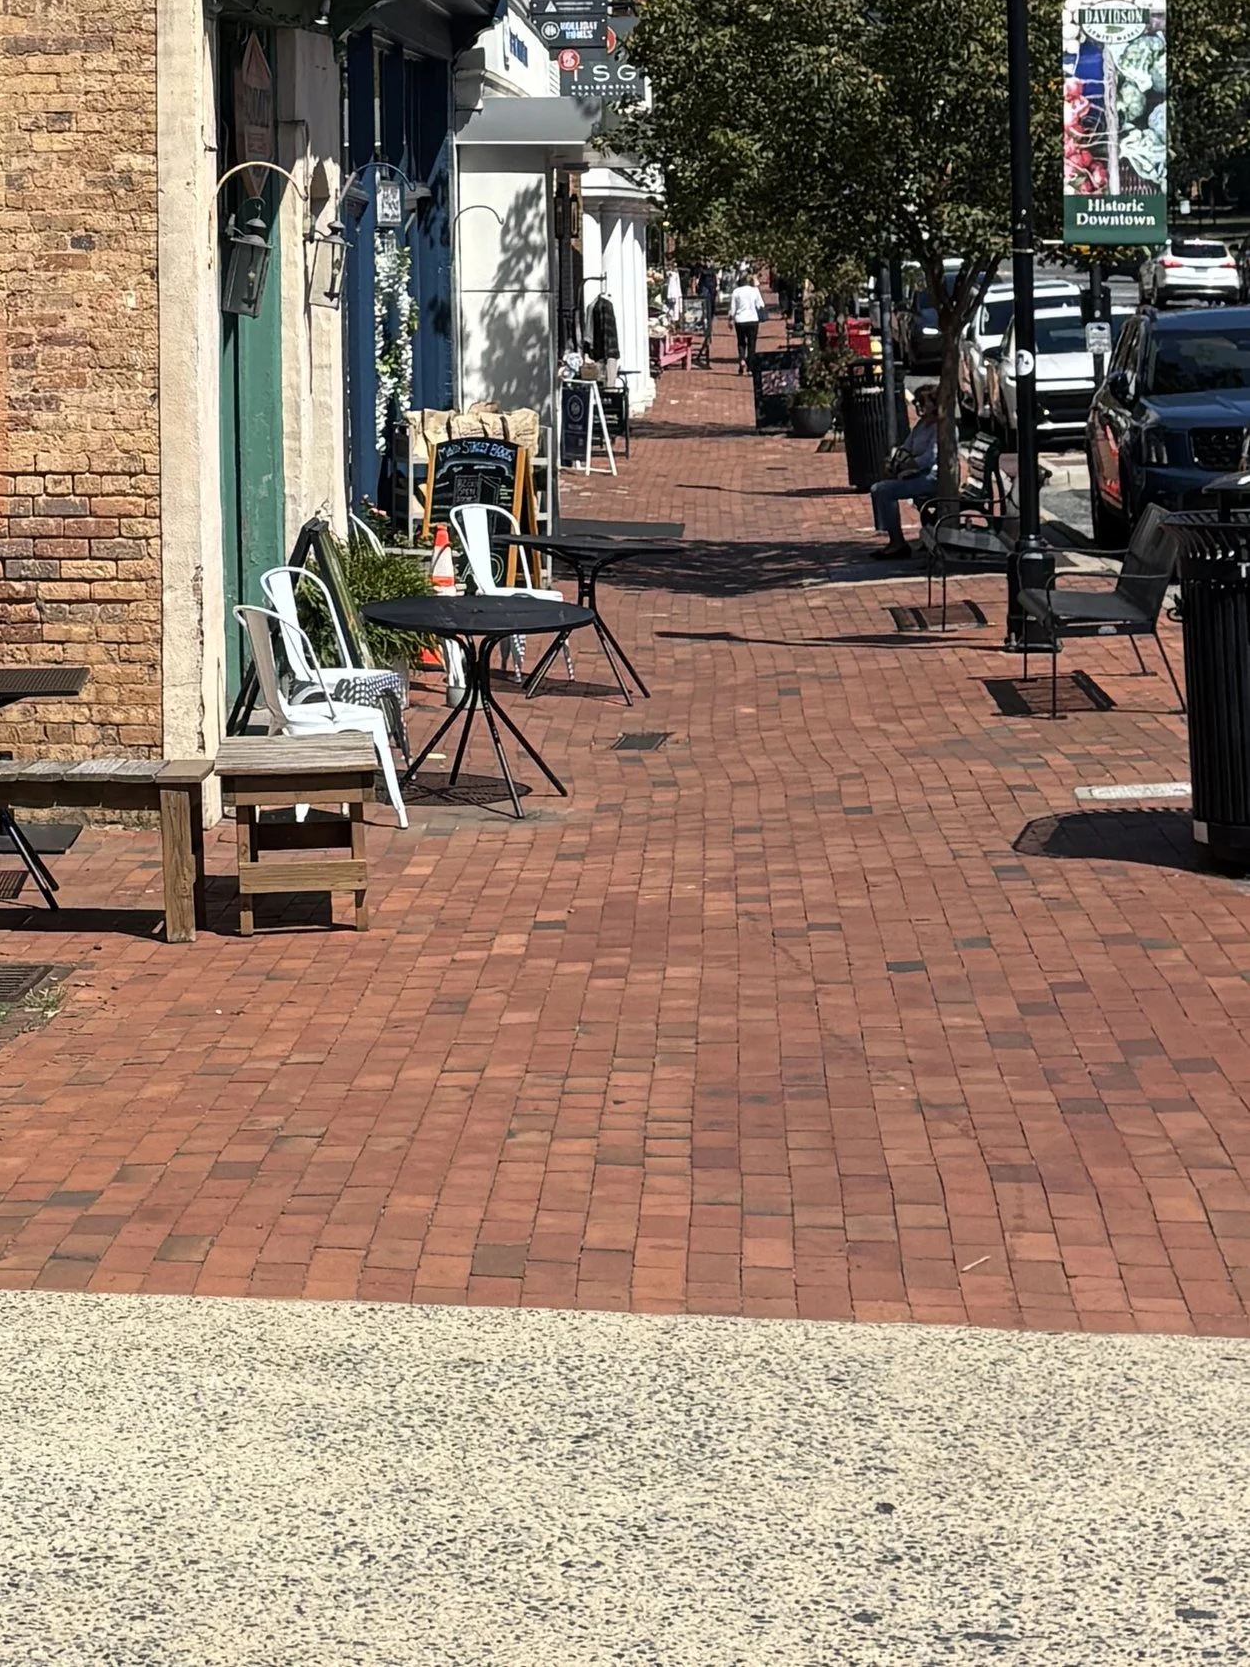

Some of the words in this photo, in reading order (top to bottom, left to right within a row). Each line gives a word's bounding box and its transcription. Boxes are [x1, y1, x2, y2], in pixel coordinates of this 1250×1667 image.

[1084, 9, 1143, 23] DAVIDSON
[1088, 199, 1144, 212] Historic
[1076, 211, 1156, 226] Downtown
